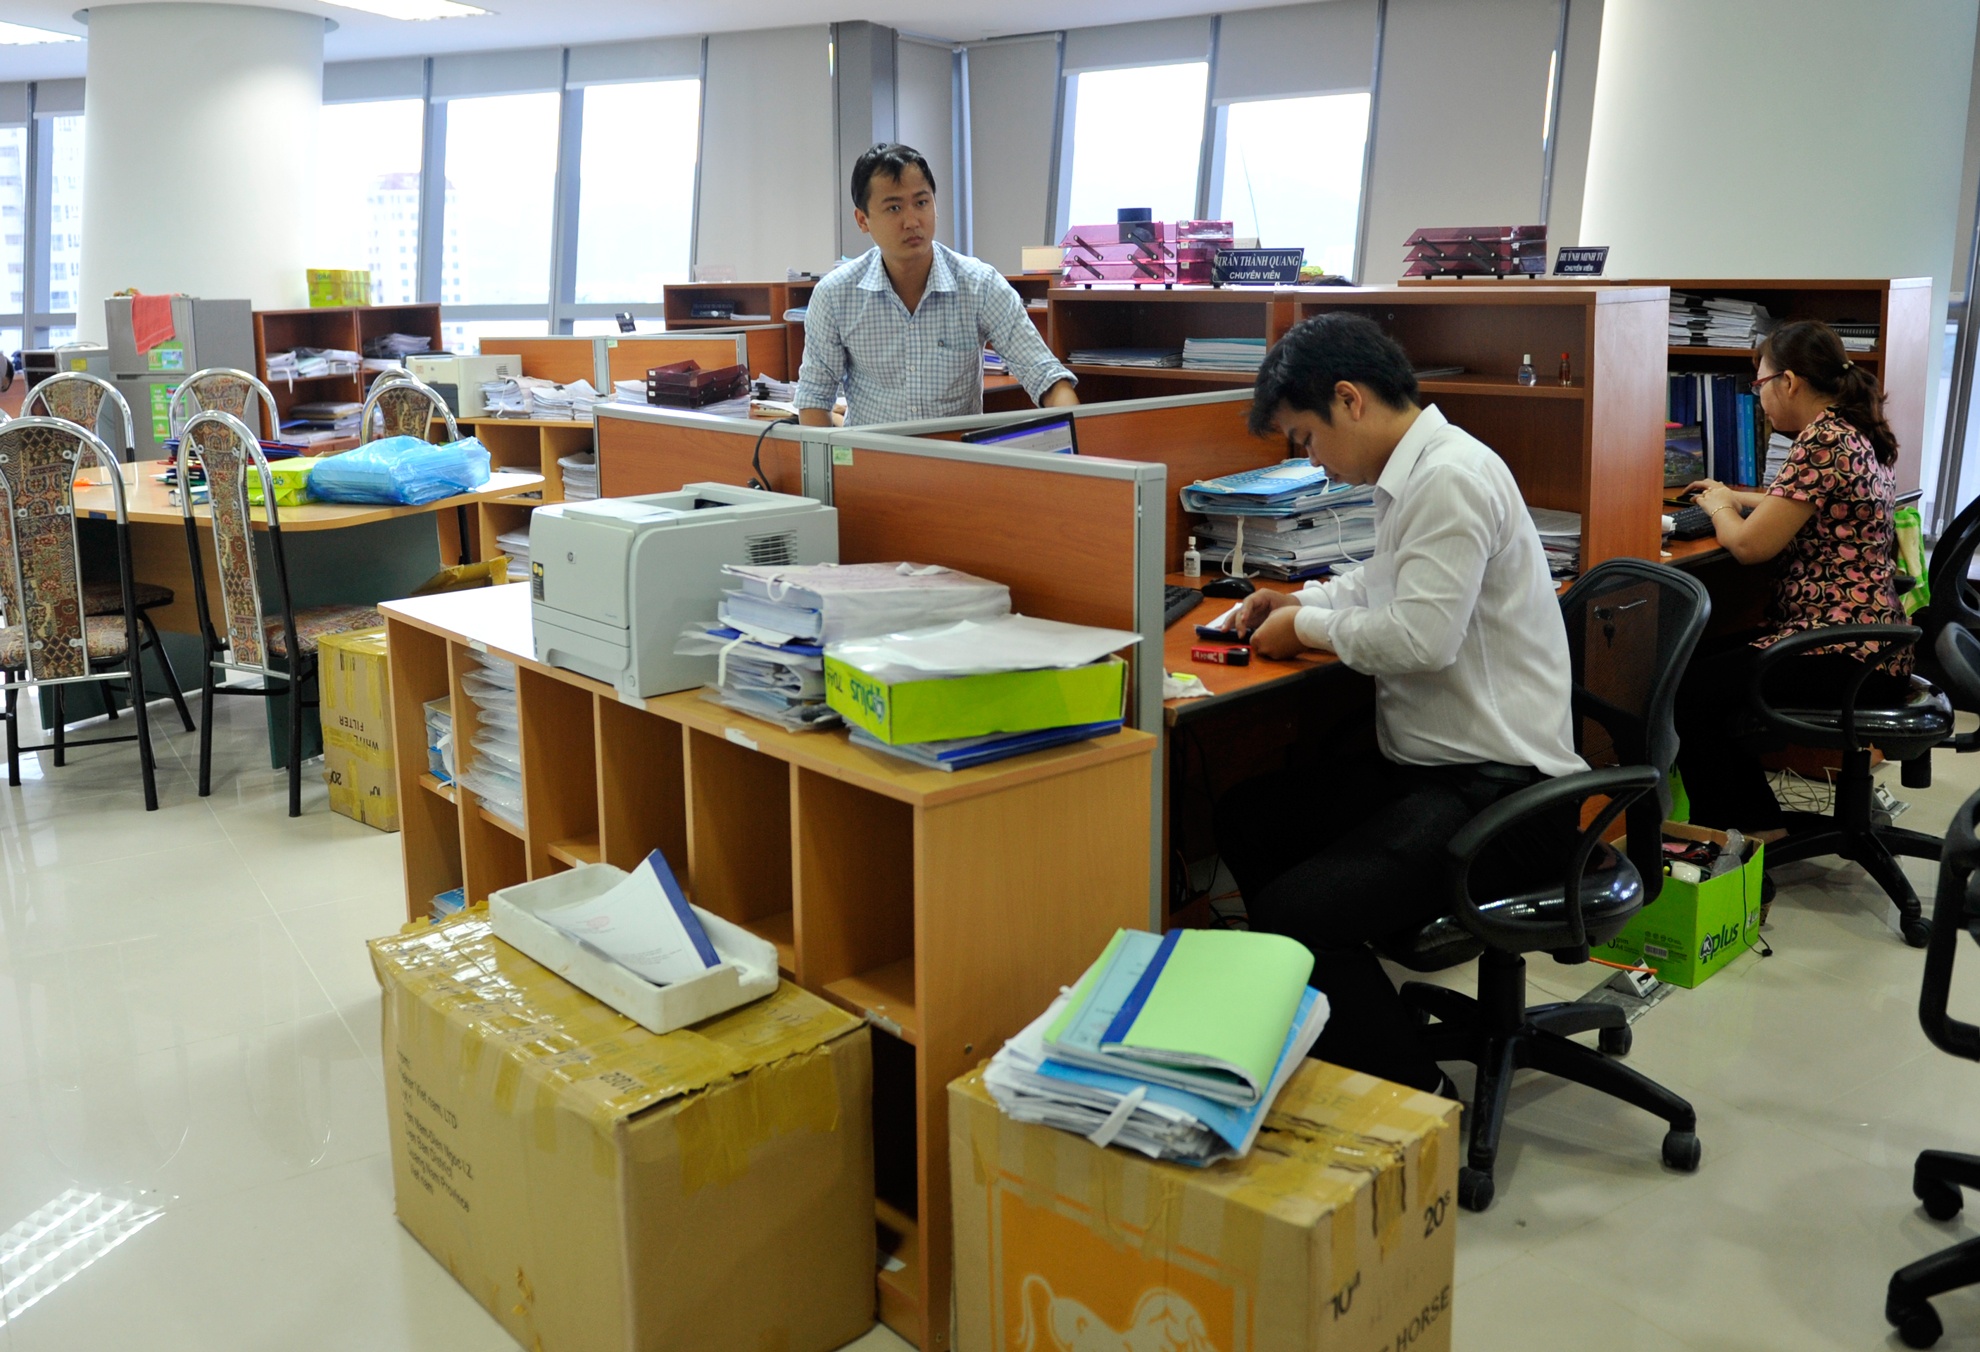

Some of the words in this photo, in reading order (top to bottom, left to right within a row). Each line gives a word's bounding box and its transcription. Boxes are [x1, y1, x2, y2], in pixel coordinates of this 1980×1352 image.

[1218, 252, 1239, 267] TRẦN
[1240, 253, 1269, 267] THÀNH
[1269, 256, 1299, 269] QUANG
[1229, 269, 1261, 280] CHUYÊN
[1262, 269, 1281, 280] VIÊN
[338, 715, 364, 732] FILTER
[1710, 922, 1739, 961] plus
[1396, 1284, 1450, 1352] HORSE
